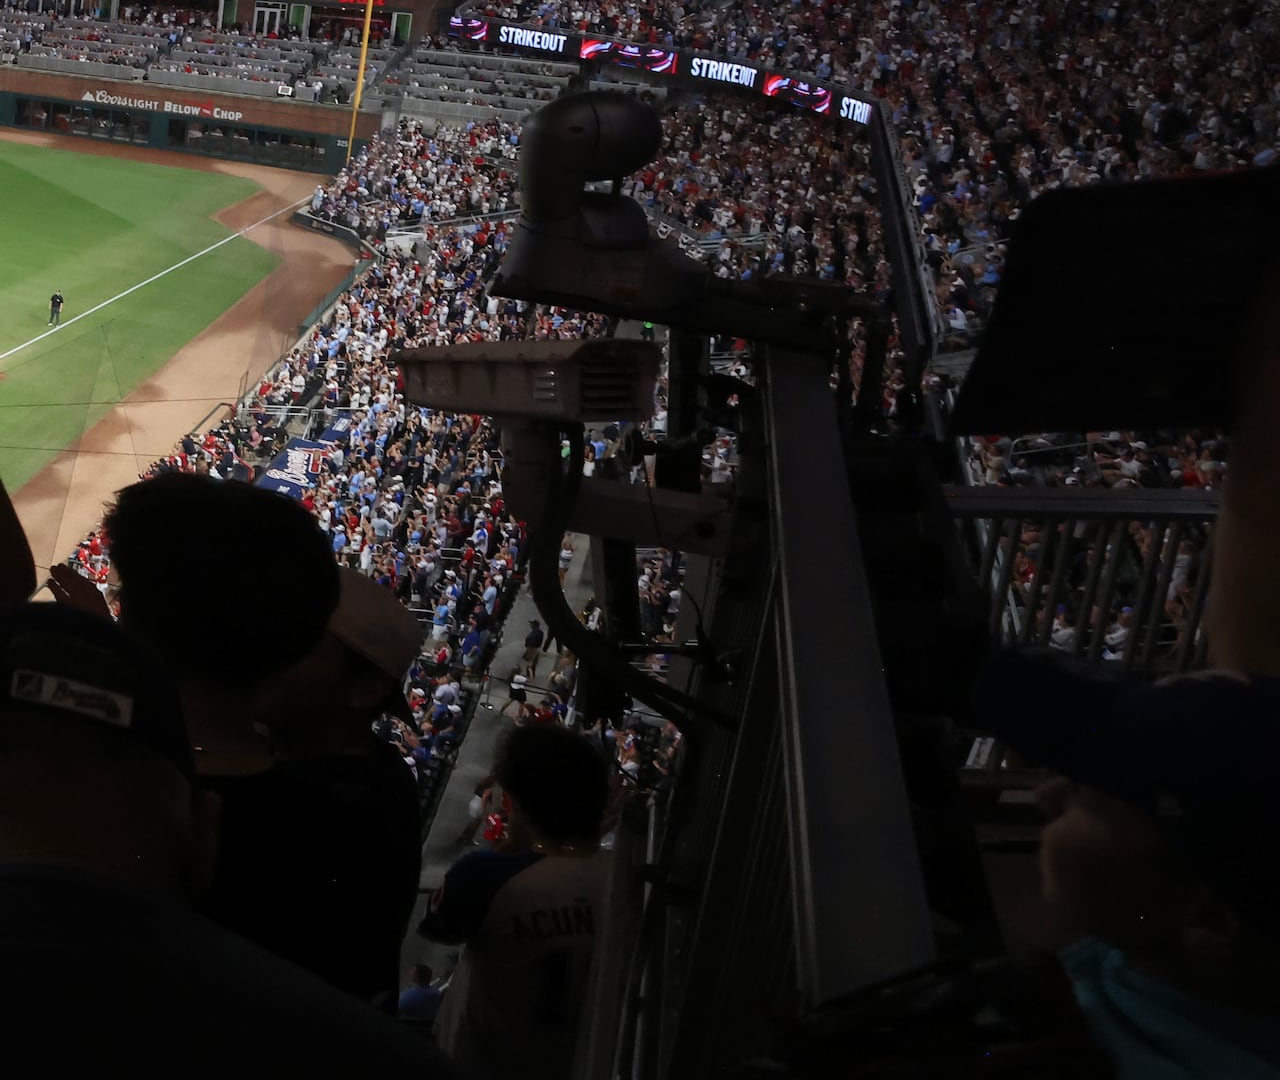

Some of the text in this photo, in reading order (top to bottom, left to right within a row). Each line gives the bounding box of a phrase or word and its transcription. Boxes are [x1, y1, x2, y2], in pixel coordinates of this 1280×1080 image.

[499, 24, 568, 53] STRIKEOUT
[691, 56, 758, 89] STRIKEOUT
[94, 89, 129, 108] Coors
[128, 97, 160, 111] LIGHT
